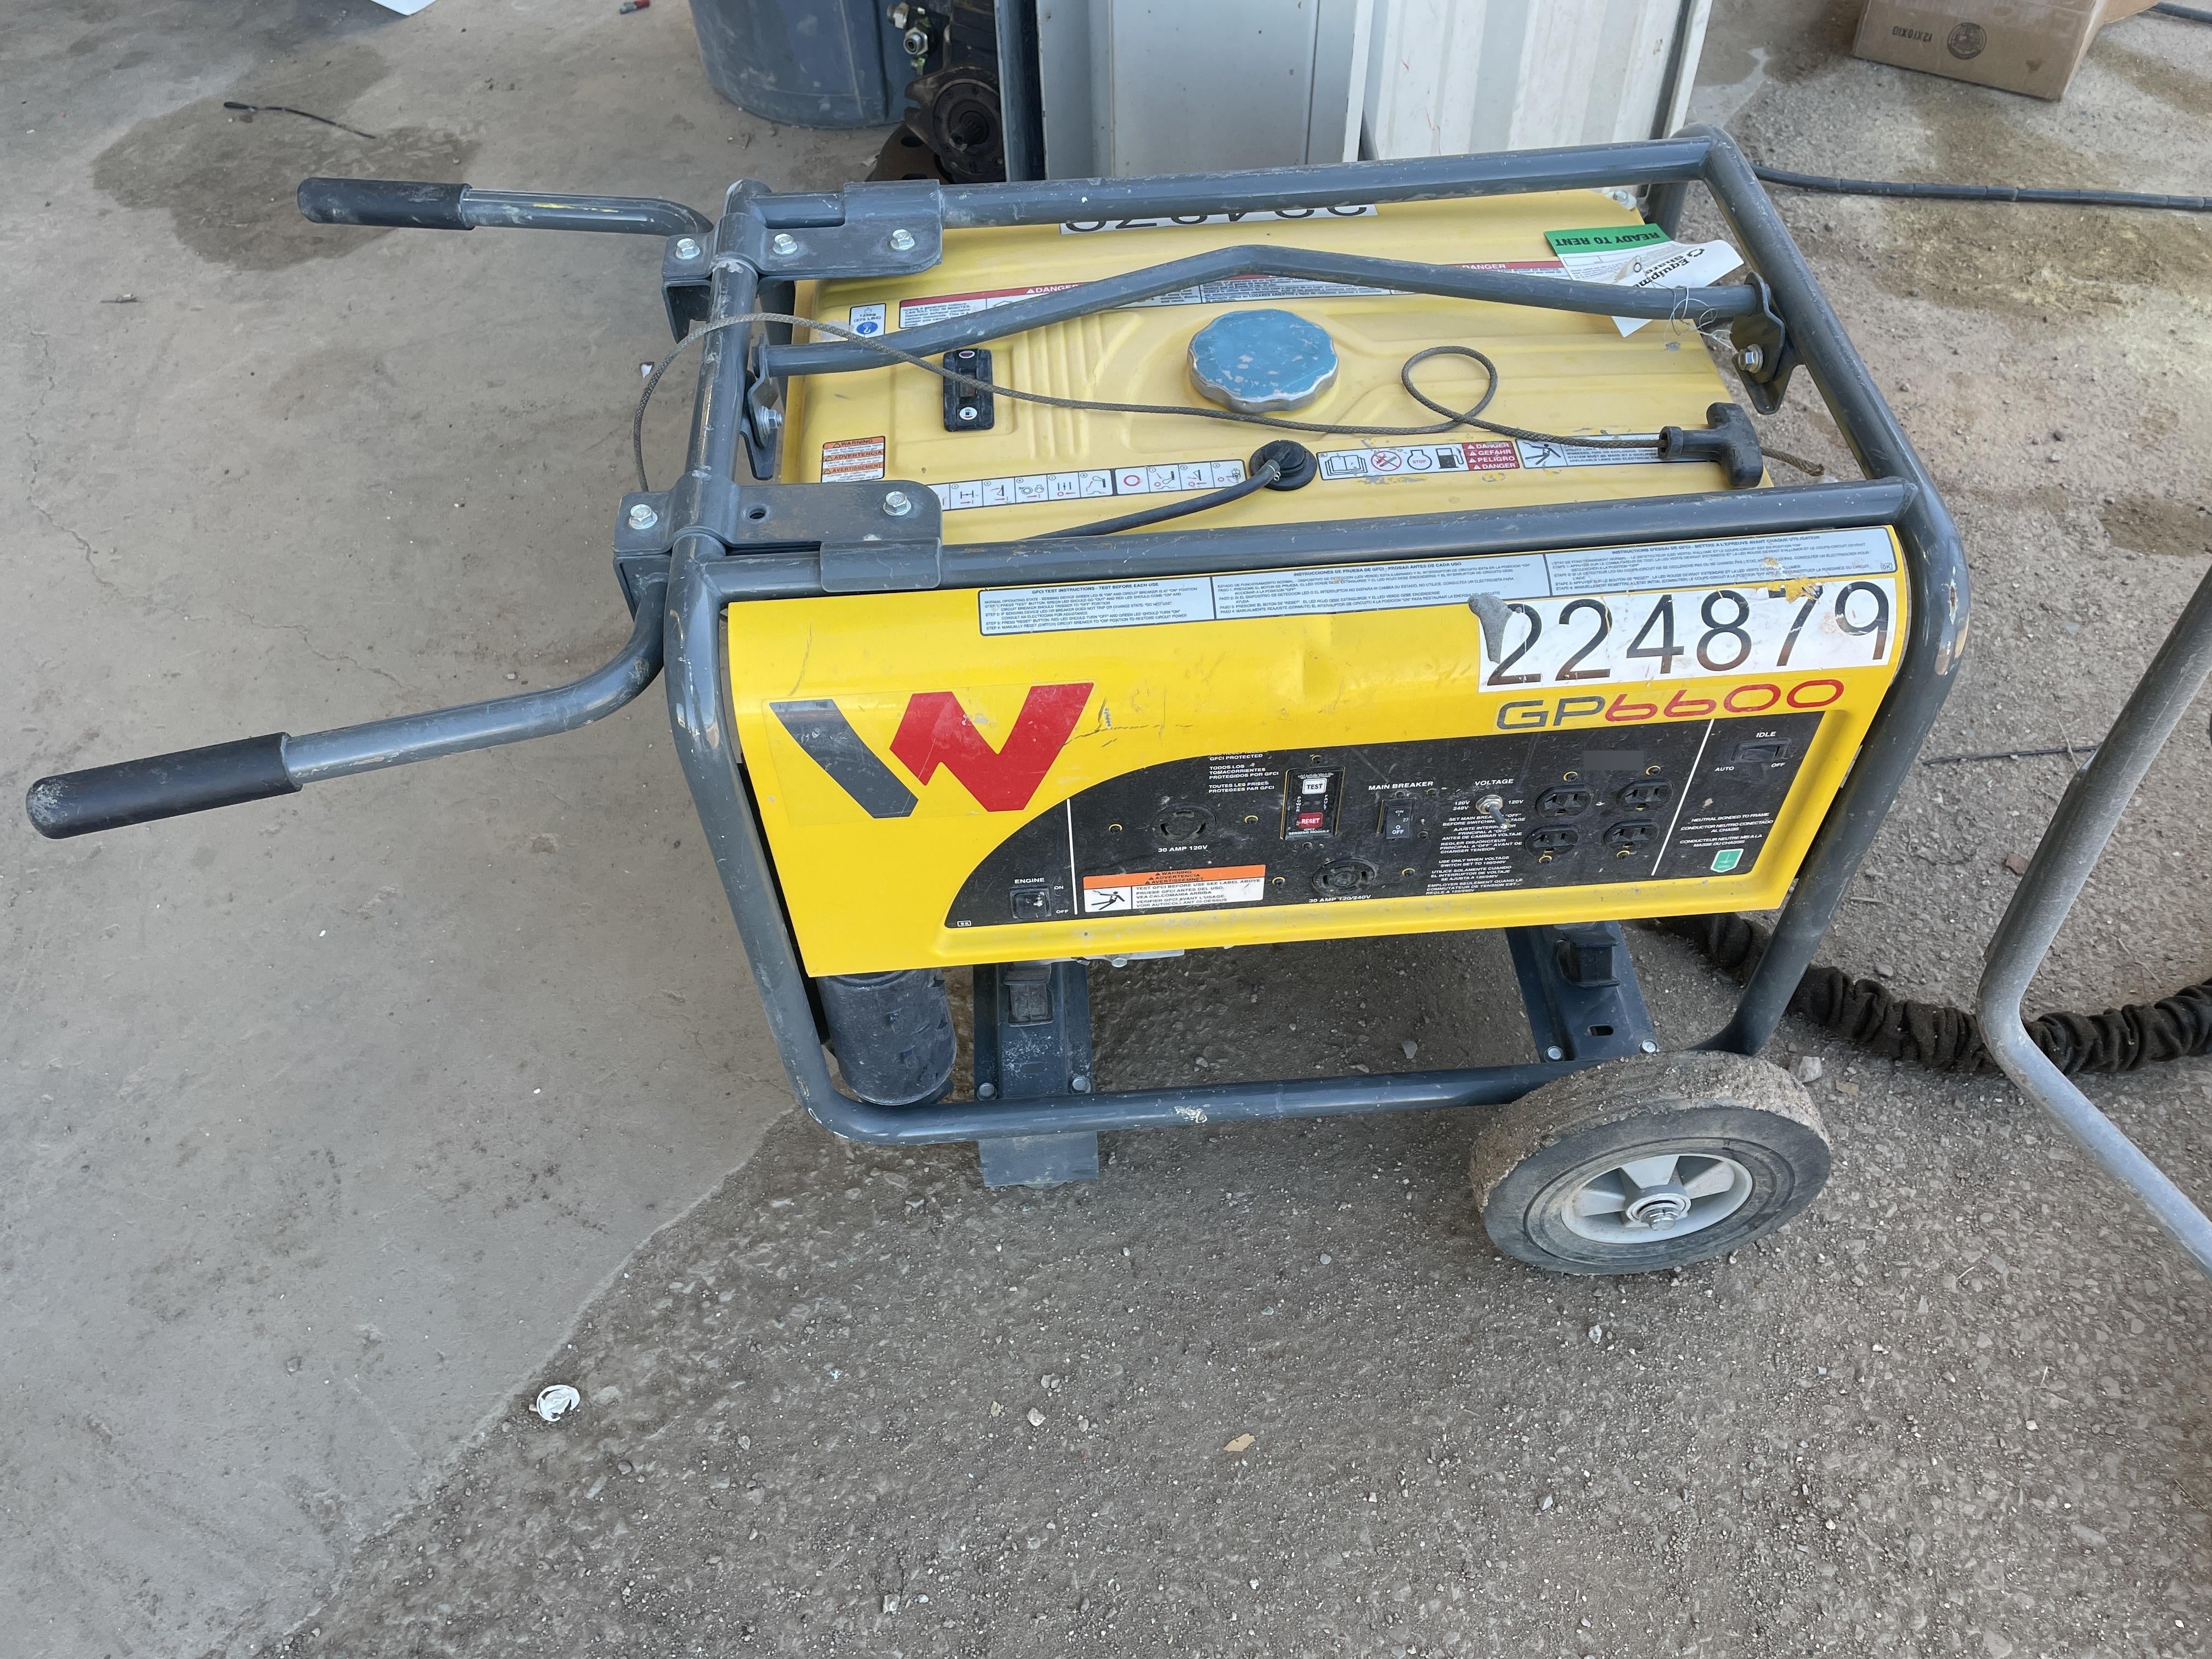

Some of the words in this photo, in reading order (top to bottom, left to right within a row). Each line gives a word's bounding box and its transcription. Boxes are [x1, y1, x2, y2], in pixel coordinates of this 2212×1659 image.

[1556, 238, 1589, 246] RENT
[1594, 236, 1612, 244] TO
[1616, 233, 1661, 244] READY
[834, 450, 882, 459] ADVERTENCIA
[1487, 581, 1891, 686] 224879
[1496, 679, 1844, 730] GP6600
